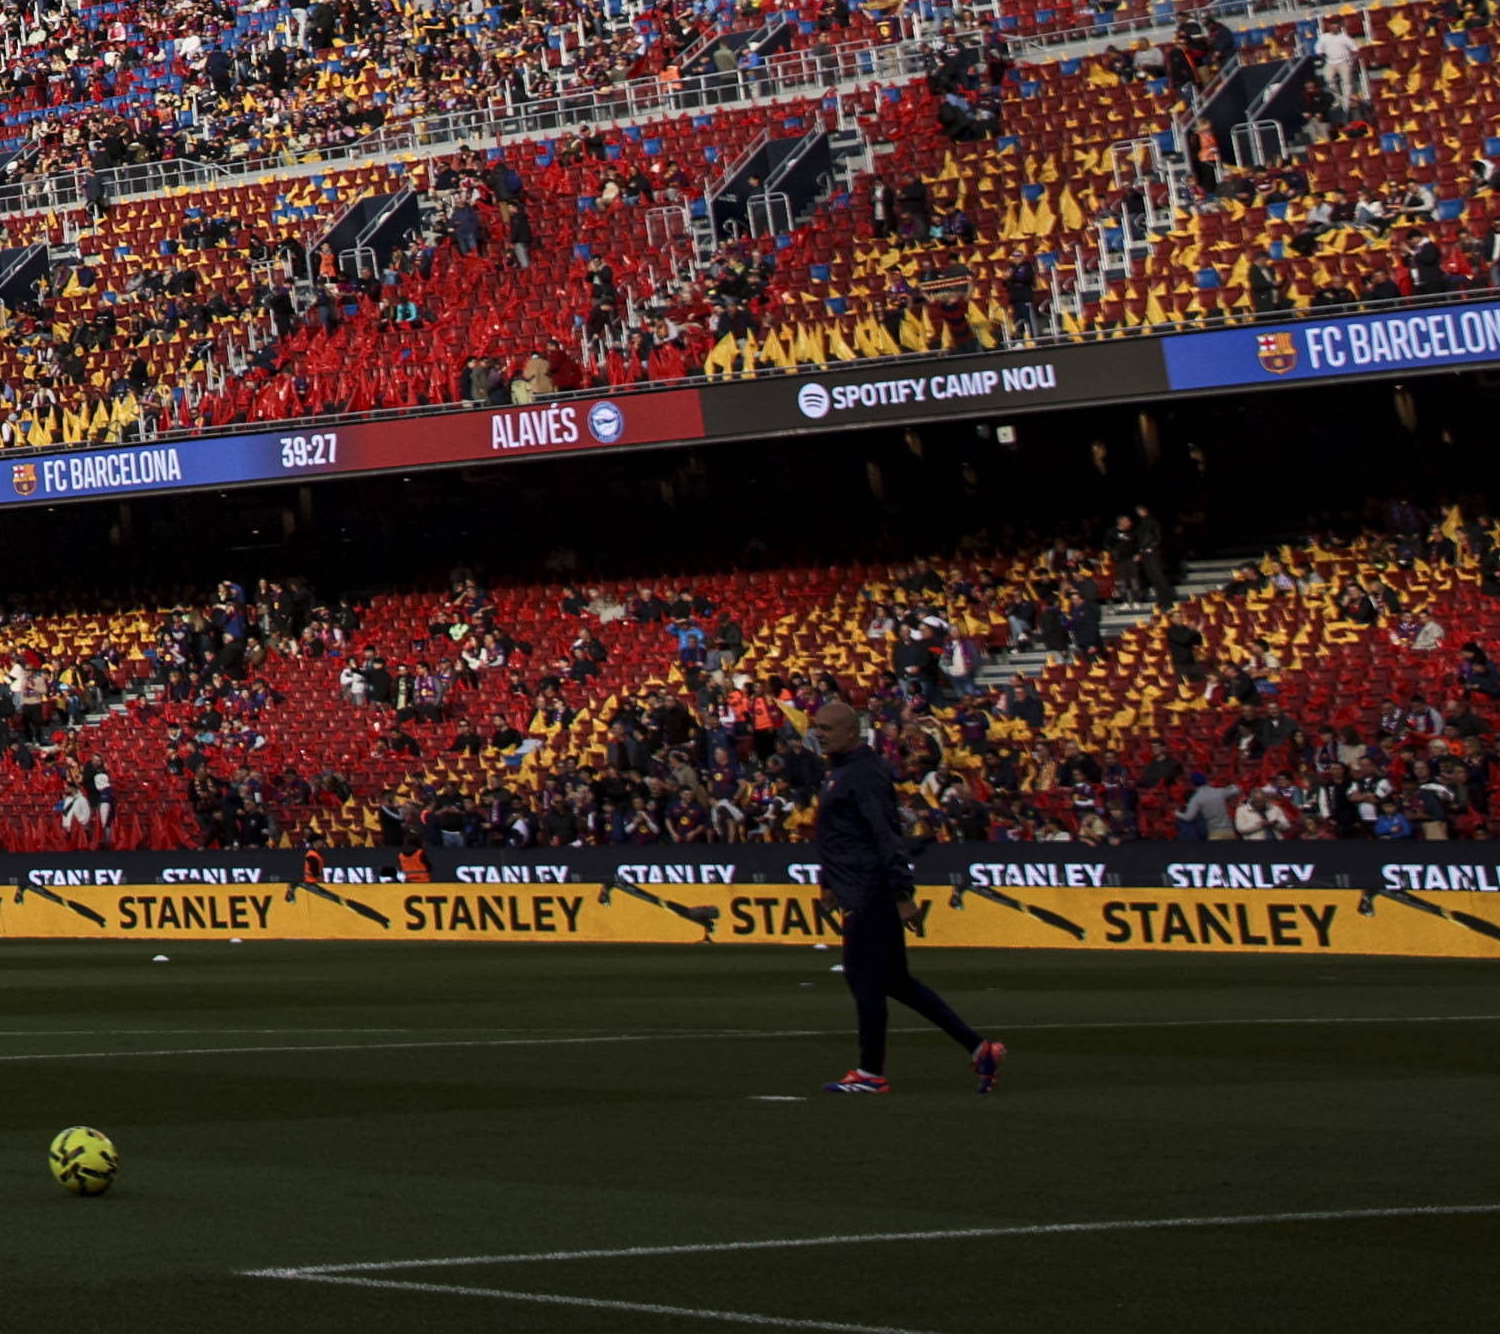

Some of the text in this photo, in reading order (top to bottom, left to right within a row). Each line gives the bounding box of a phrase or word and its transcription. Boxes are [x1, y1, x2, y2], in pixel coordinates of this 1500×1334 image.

[1306, 310, 1500, 368] FC BARCELON
[833, 365, 1055, 409] SPOTIFY CAMP NOU
[493, 401, 578, 449] ALAVÉS
[281, 434, 336, 467] 39:27
[44, 449, 181, 492] FC BARCELONA
[969, 863, 1105, 887] STANLEY
[1167, 863, 1314, 888] STANLEY
[1382, 864, 1500, 891] STANL
[118, 896, 273, 930] STANLEY
[404, 895, 583, 932] STANLEY
[1104, 901, 1337, 947] STANLEY
